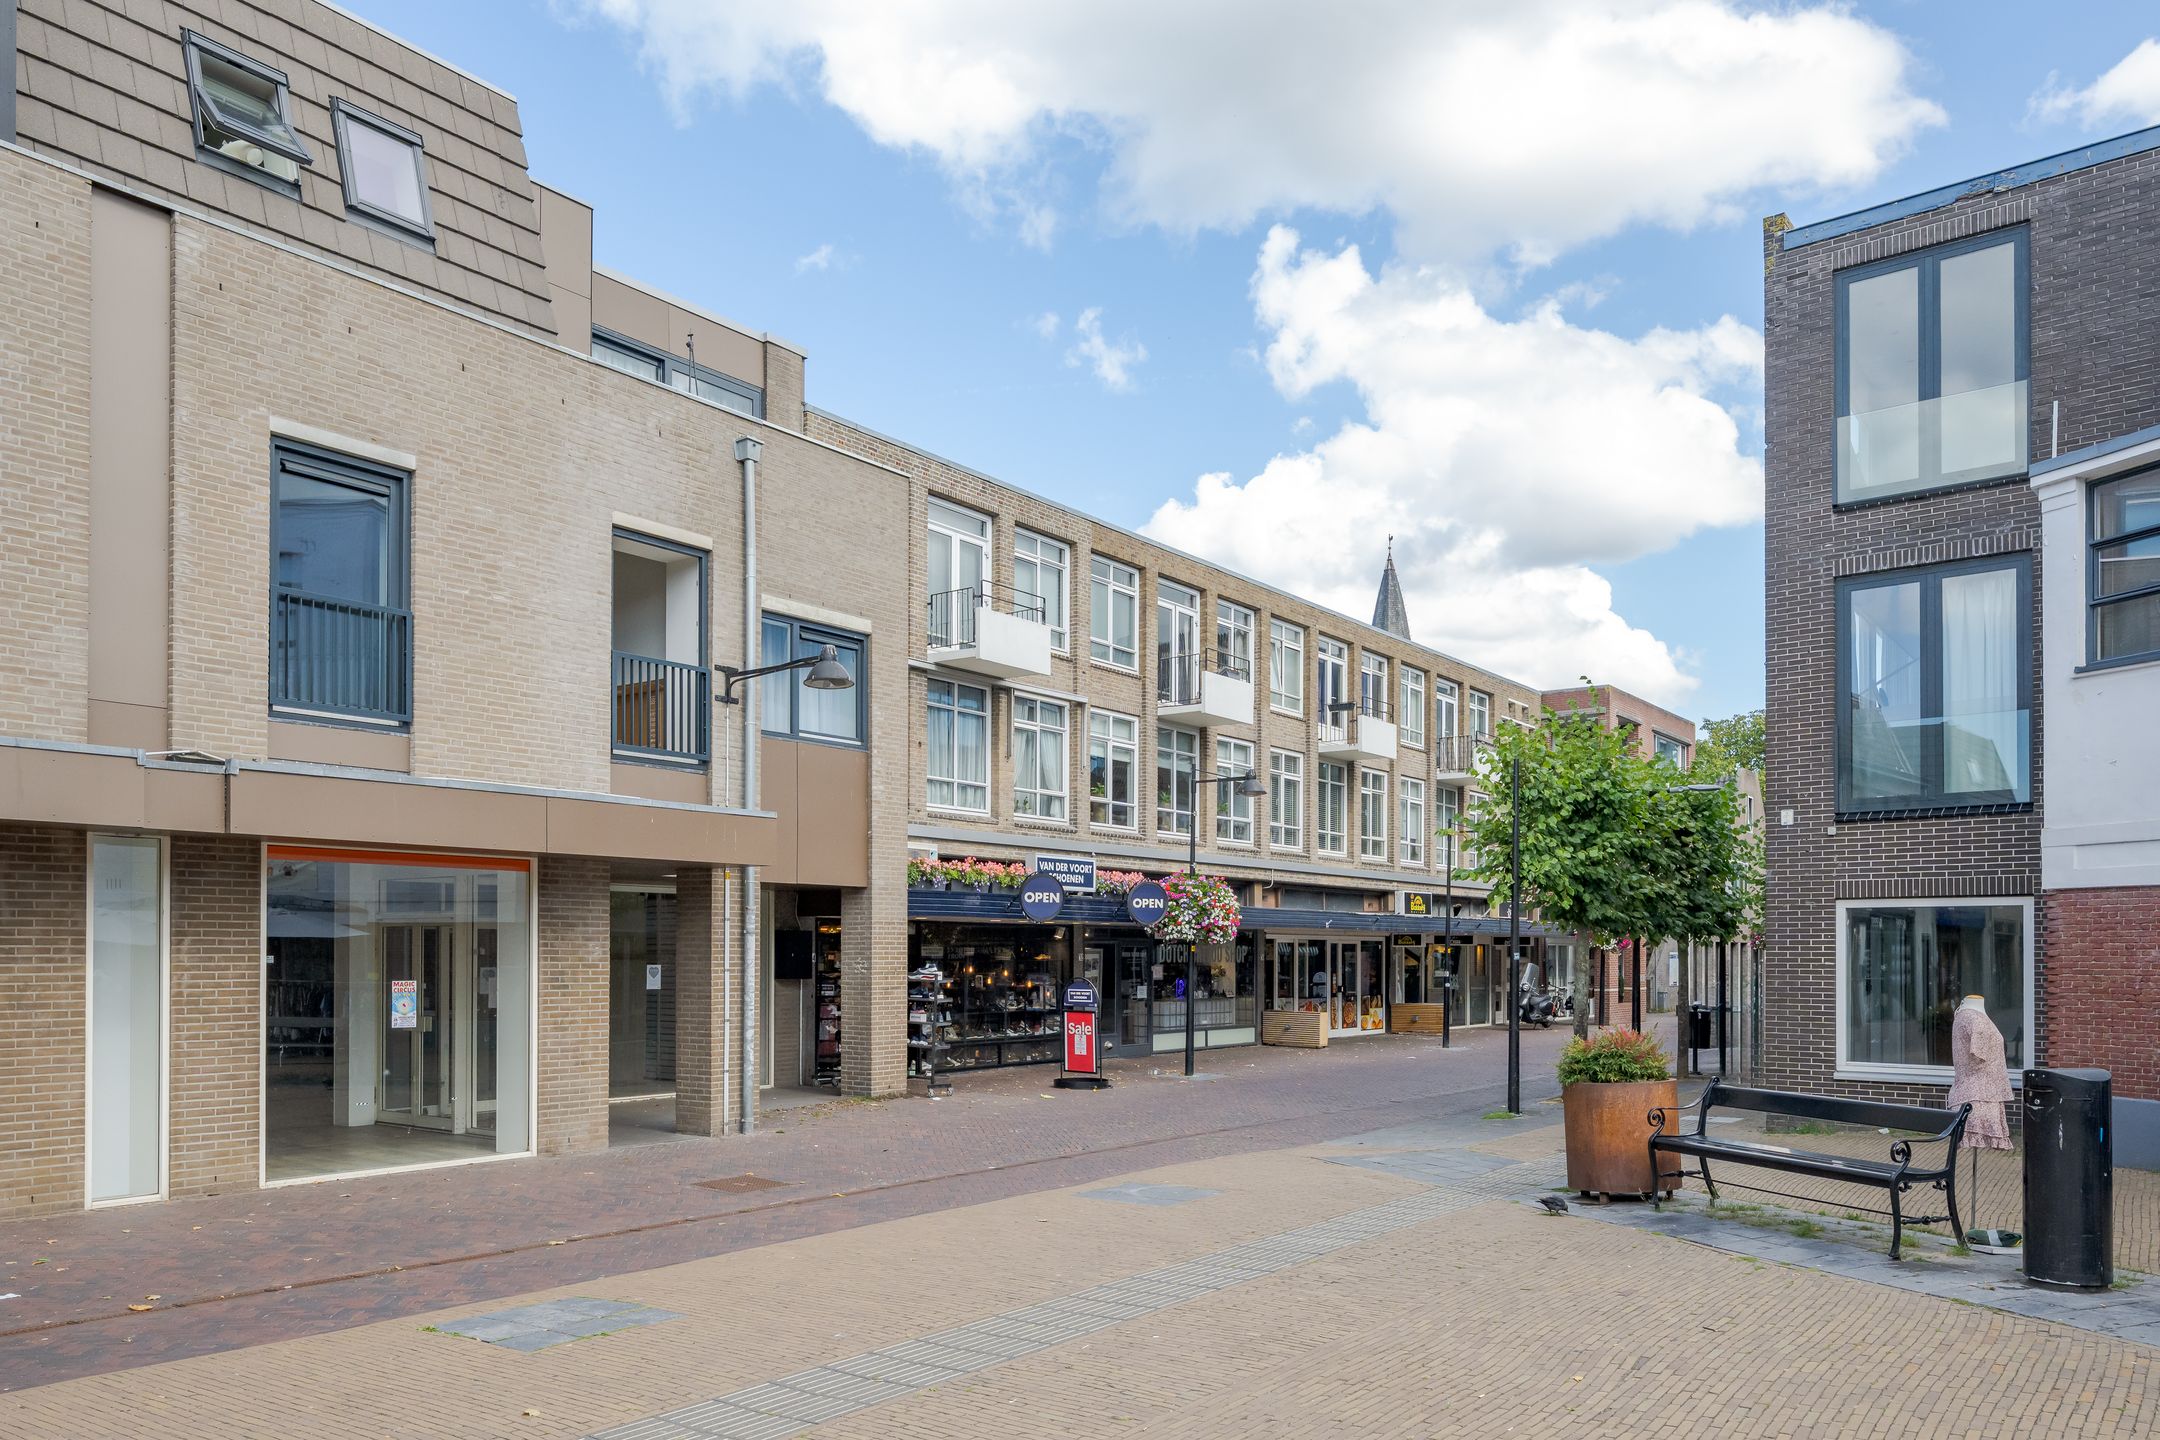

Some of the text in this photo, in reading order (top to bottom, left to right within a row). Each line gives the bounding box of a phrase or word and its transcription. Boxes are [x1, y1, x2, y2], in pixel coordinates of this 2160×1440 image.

[1039, 861, 1093, 874] VAN DER VOORT
[1049, 872, 1084, 884] CHOENEN
[1024, 891, 1060, 904] OPEN
[1132, 898, 1164, 909] OPEN
[1225, 945, 1248, 963] SHOP
[1068, 1022, 1092, 1035] Sale
